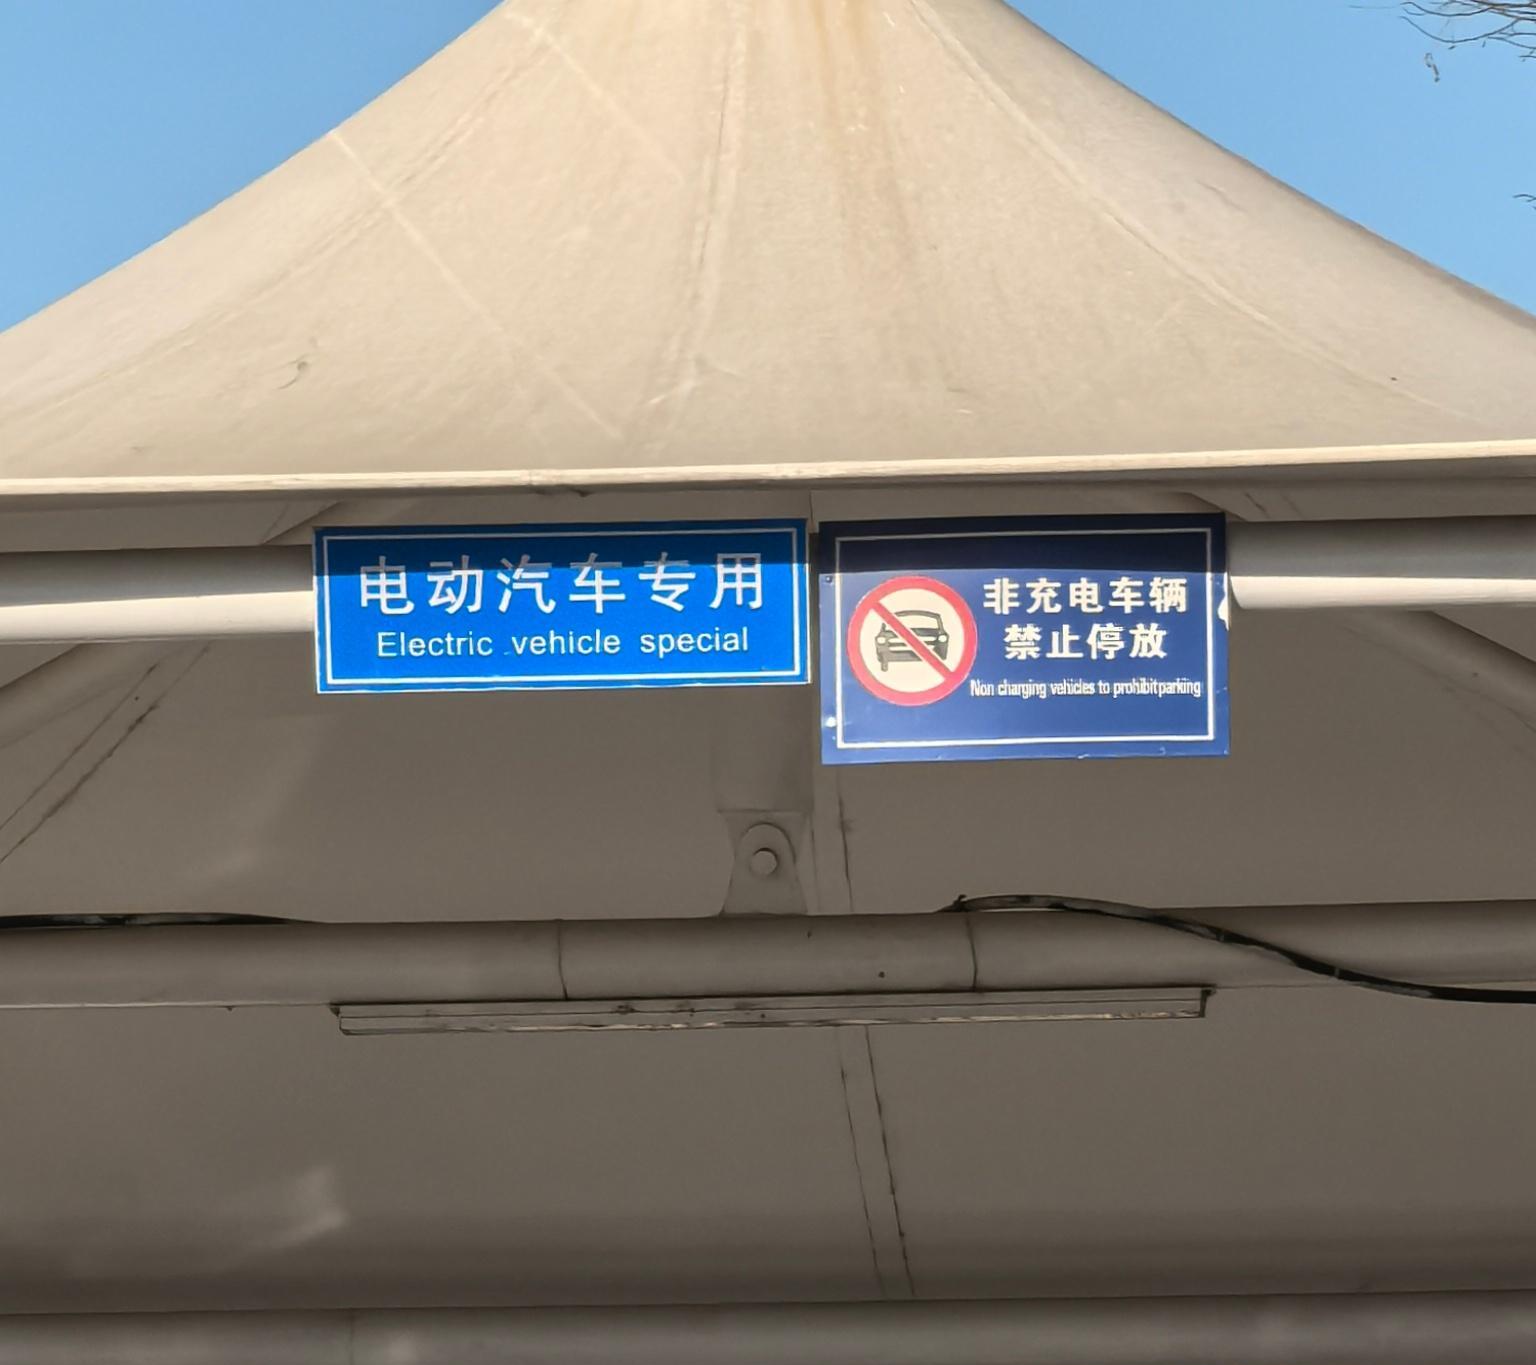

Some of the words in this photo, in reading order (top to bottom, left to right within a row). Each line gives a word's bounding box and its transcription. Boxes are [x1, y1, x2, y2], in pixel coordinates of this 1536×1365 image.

[360, 552, 763, 615] 电动汽车专用
[983, 577, 1187, 614] 非充电车辆
[377, 632, 493, 656] Electric
[512, 629, 621, 654] vehicle
[640, 627, 748, 658] special
[1004, 623, 1168, 660] 禁止停放
[970, 679, 994, 697] Non
[997, 679, 1047, 699] charging
[1050, 678, 1095, 695] vehicles
[1098, 679, 1110, 695] to
